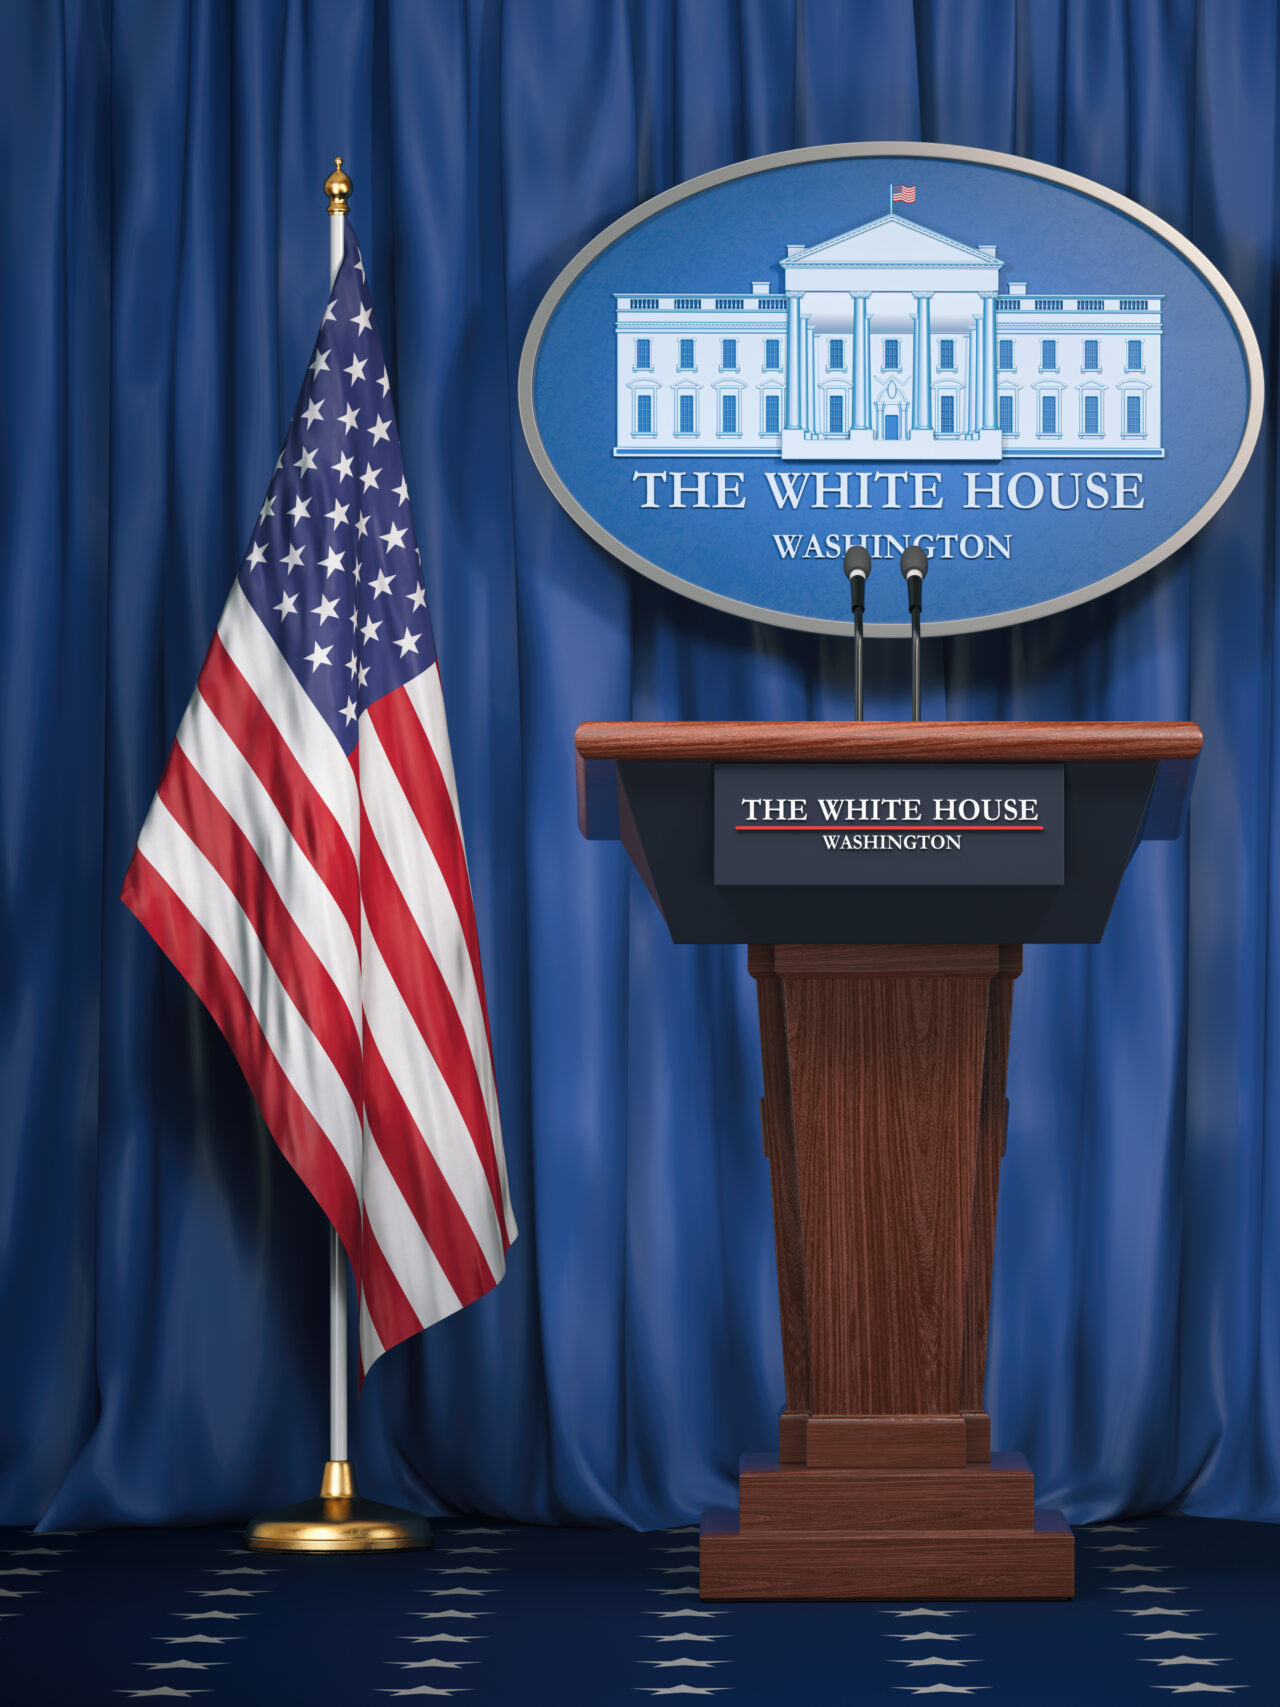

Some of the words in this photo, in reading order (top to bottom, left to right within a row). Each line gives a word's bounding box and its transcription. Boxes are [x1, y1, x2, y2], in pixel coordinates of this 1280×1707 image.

[632, 471, 746, 510] THE
[764, 471, 944, 510] WHITE
[963, 471, 1145, 510] HOUSE
[772, 533, 1013, 559] WASHINGTON
[741, 798, 808, 821] THE
[817, 798, 922, 821] WHITE
[932, 798, 1039, 821] HOUSE
[822, 834, 962, 850] WASHINGTON
